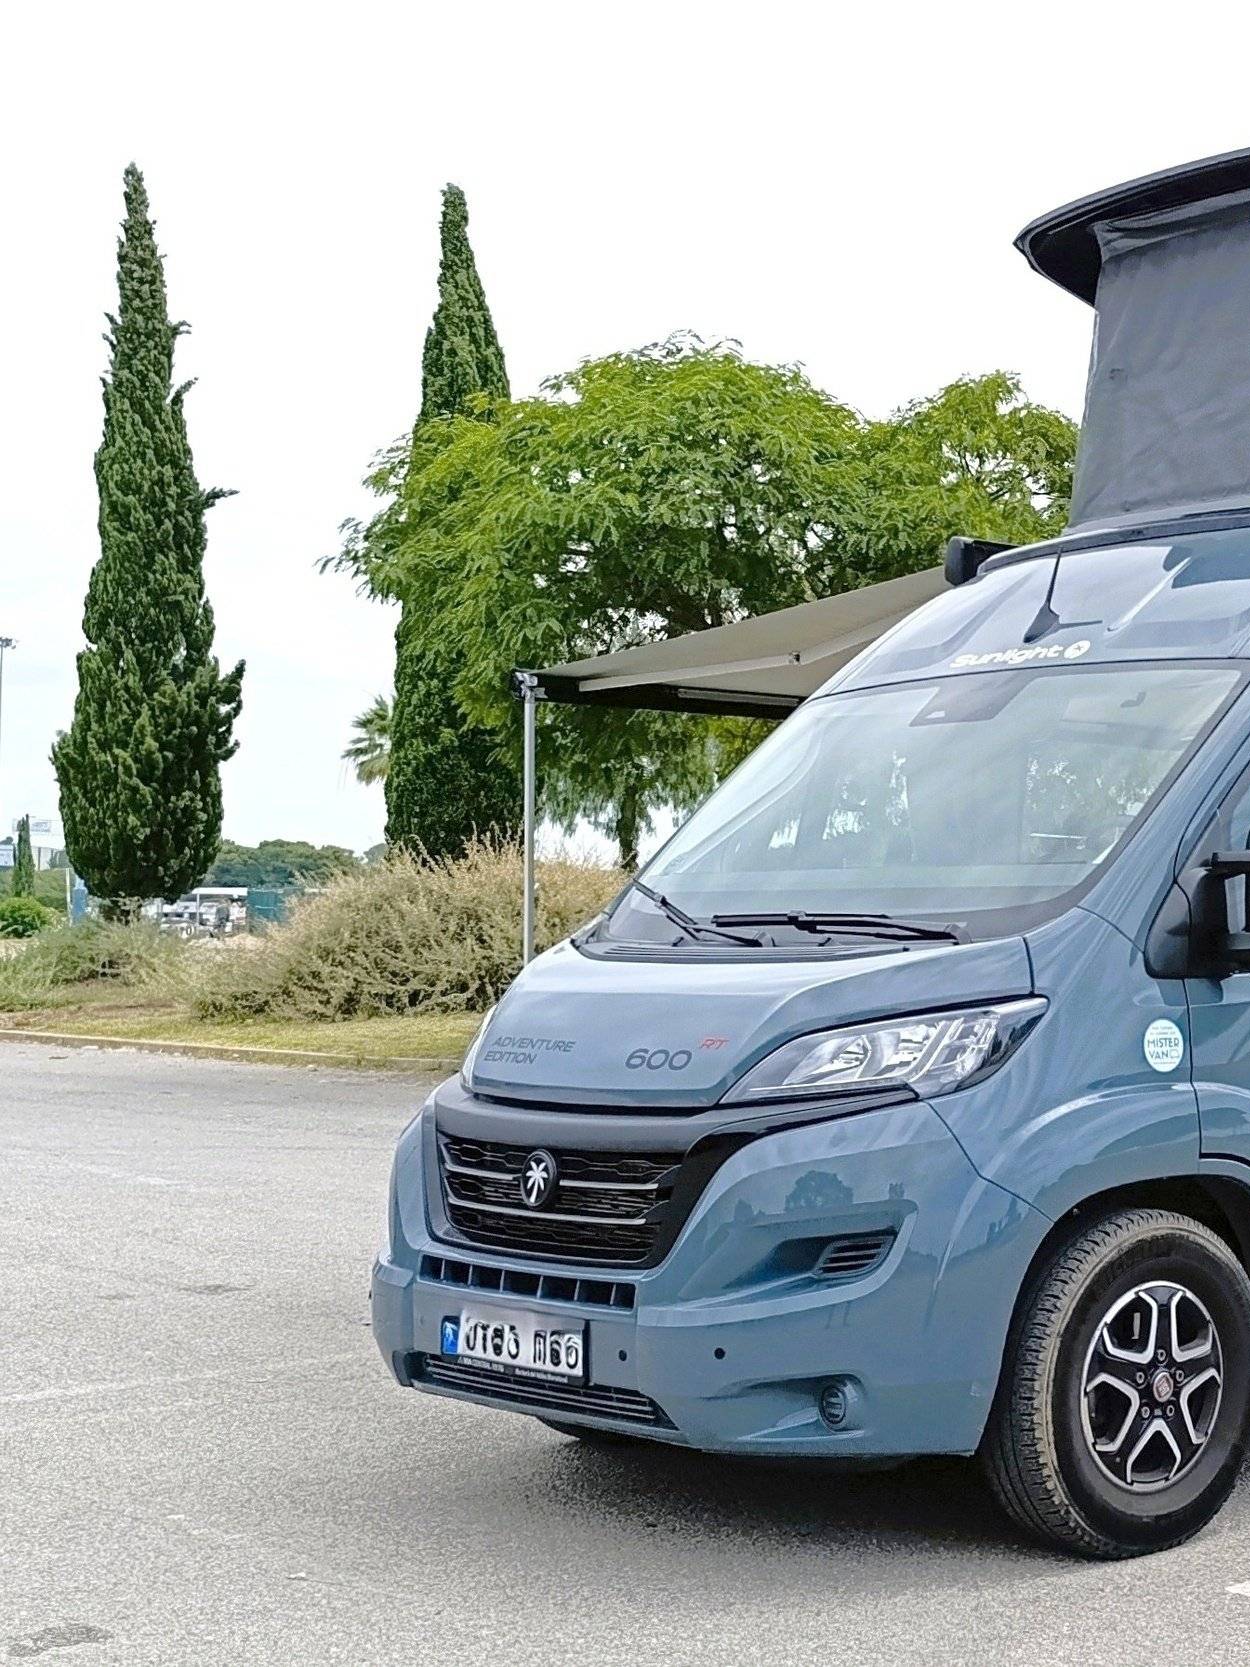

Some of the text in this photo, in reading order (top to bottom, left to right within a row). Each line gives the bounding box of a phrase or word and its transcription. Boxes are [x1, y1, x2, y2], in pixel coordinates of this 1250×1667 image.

[951, 644, 1064, 667] Sunlight
[492, 1036, 576, 1053] ADVENTURE
[1147, 1037, 1180, 1048] MISTER
[483, 1050, 538, 1065] EDITION
[625, 1038, 730, 1071] 600 RT
[1148, 1049, 1169, 1060] VAN
